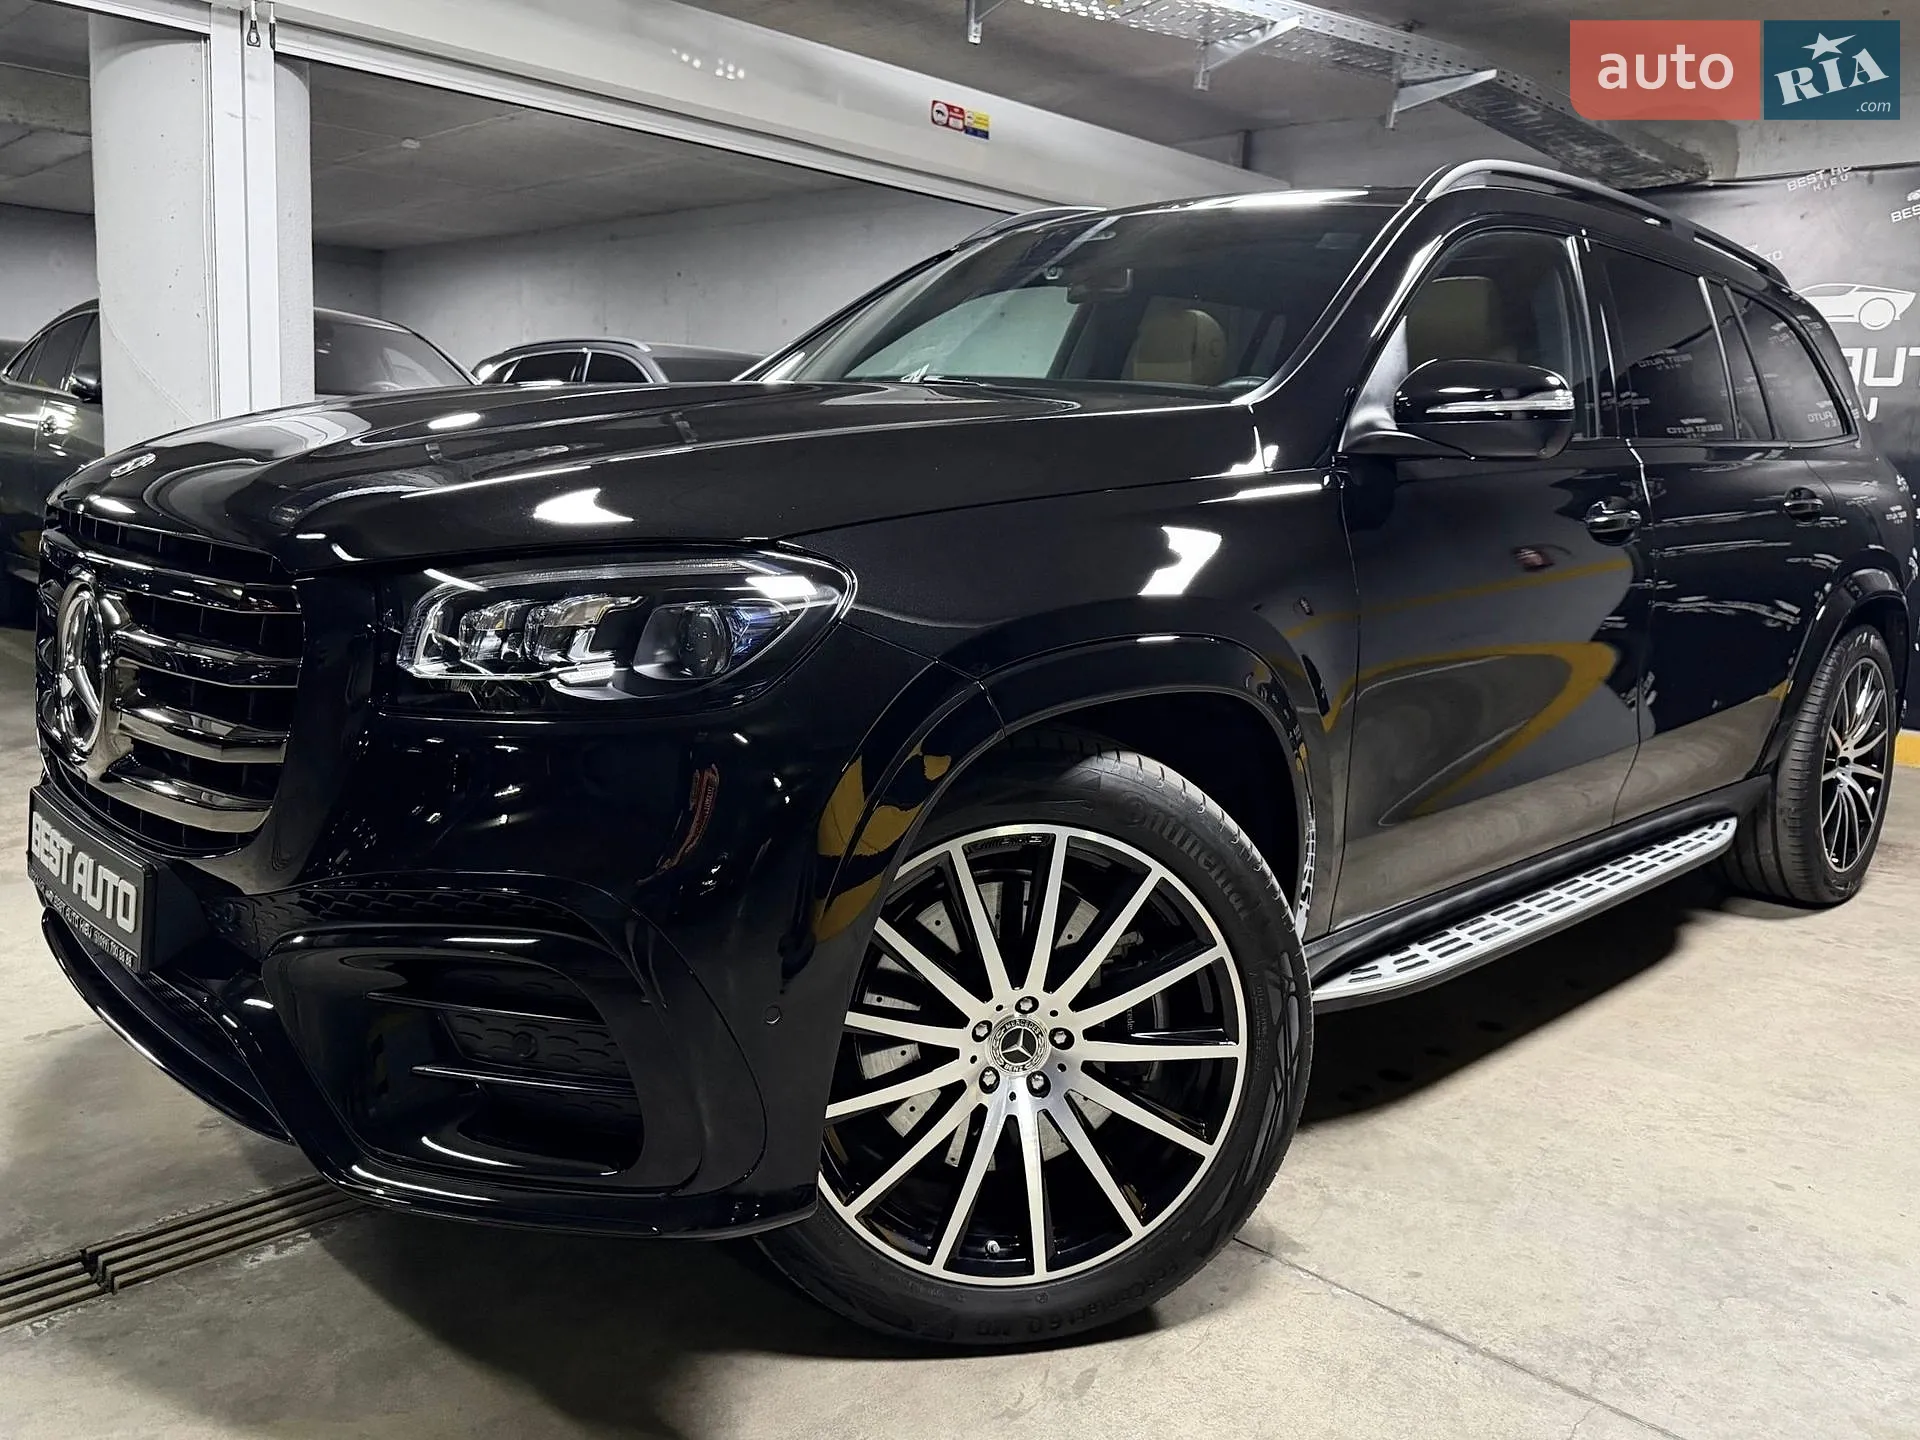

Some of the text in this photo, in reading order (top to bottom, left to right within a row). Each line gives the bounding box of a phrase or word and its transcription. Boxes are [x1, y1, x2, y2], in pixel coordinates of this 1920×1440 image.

[1787, 169, 1825, 191] BEST
[31, 811, 76, 886] BEST
[72, 851, 137, 934] AUTO
[1005, 1019, 1041, 1034] MERCEDES
[1004, 1063, 1024, 1073] BENZ
